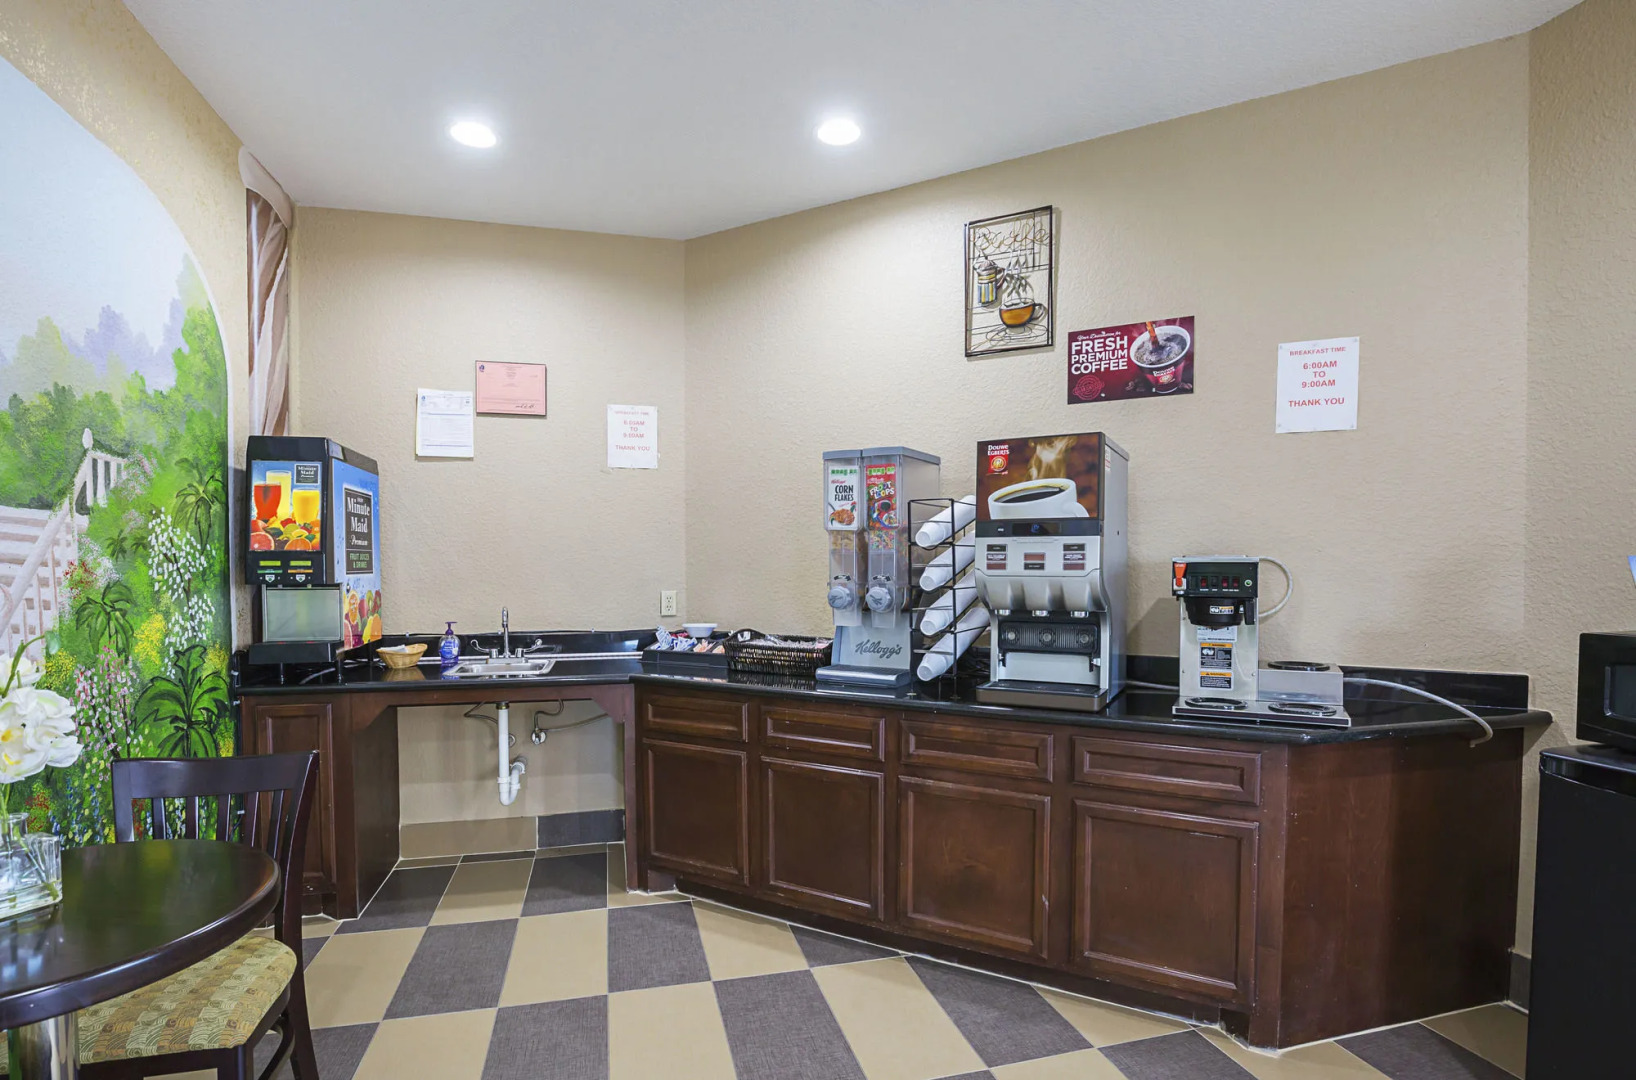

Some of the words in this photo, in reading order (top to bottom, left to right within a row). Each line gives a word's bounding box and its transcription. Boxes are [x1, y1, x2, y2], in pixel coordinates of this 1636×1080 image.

[1071, 335, 1128, 354] FRESH
[1071, 349, 1128, 364] PREMIUM
[1289, 348, 1329, 356] BREAKFAST
[1071, 359, 1128, 375] COFFEE
[1303, 360, 1337, 370] 6:00AM
[1313, 370, 1326, 378] TO
[1301, 379, 1336, 388] 9:00AM
[1288, 399, 1321, 407] THANK
[1324, 397, 1345, 405] YOU
[834, 484, 854, 494] CORN
[869, 481, 892, 496] FROOT
[874, 487, 895, 499] LOOPS
[834, 494, 854, 502] FLAKES
[347, 496, 370, 516] Minute
[350, 516, 368, 533] Maid
[855, 639, 903, 659] Kellogg's
